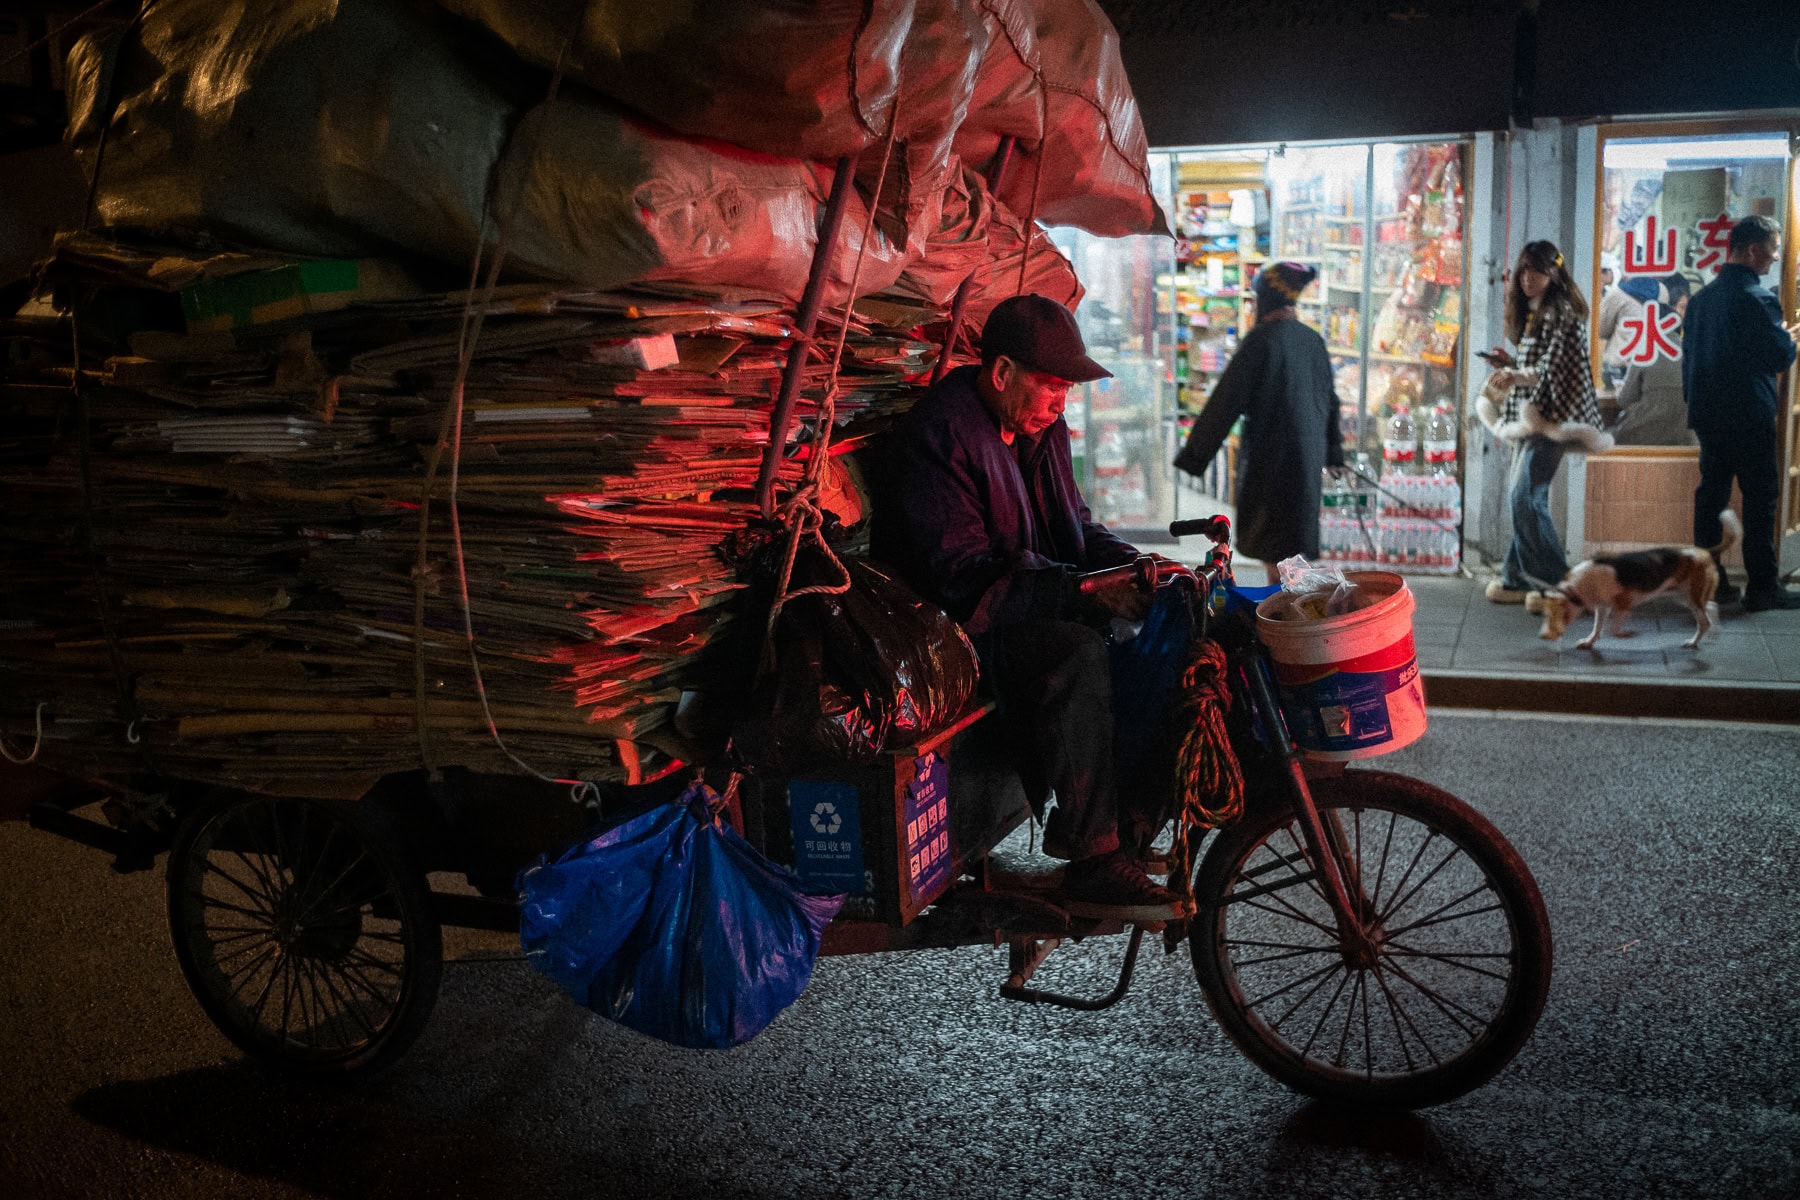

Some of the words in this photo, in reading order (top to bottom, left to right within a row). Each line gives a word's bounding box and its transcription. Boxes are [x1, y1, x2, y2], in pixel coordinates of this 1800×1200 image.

[1620, 304, 1679, 363] 水
[804, 840, 852, 852] 可回收物
